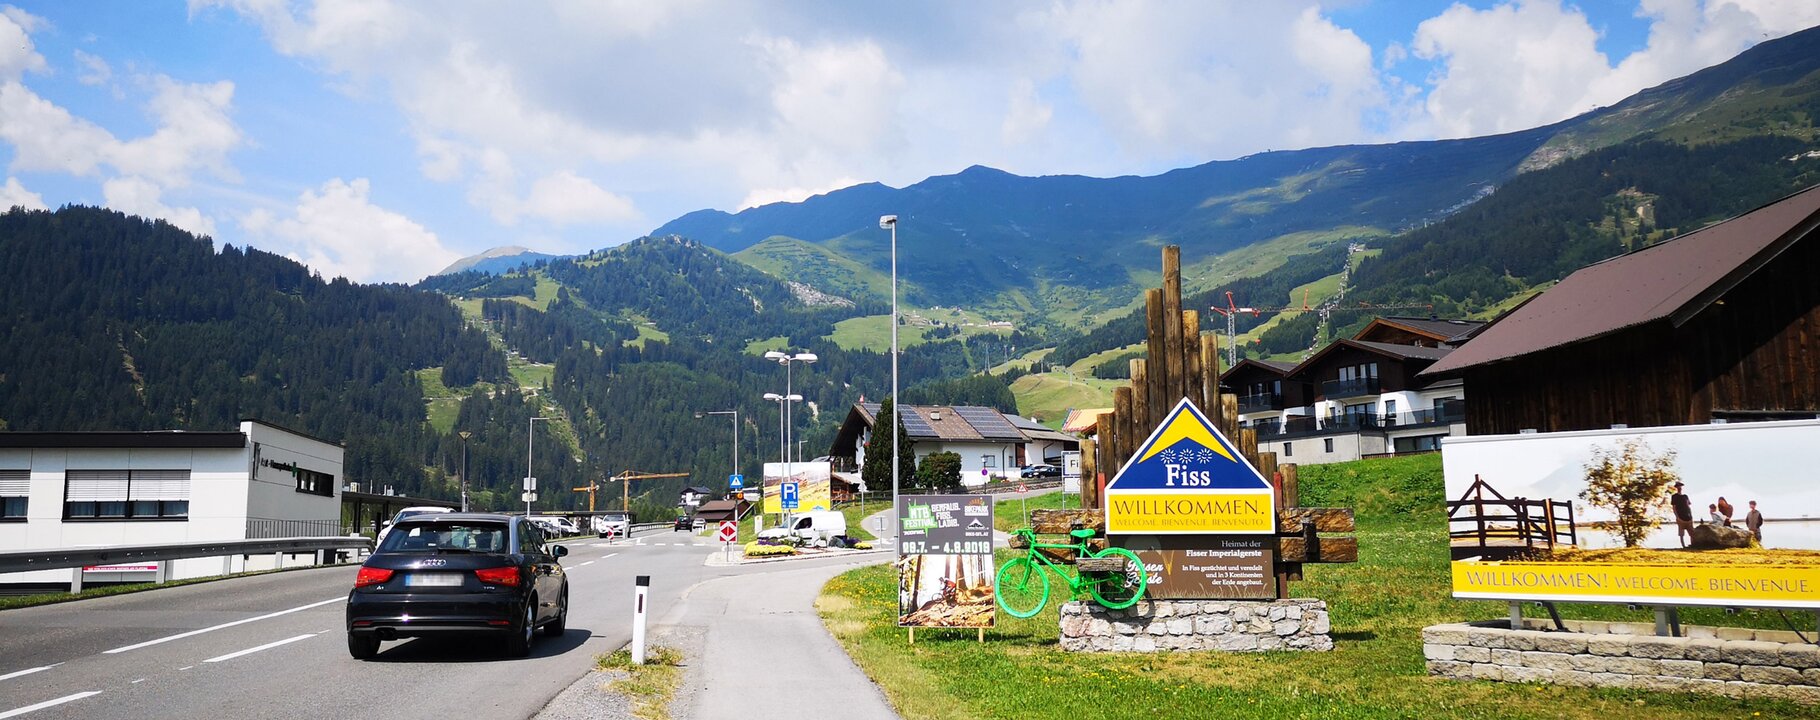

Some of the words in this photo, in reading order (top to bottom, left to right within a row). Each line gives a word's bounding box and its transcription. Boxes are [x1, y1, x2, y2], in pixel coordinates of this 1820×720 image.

[1165, 464, 1211, 486] Fiss
[910, 507, 928, 519] MTB
[1114, 499, 1265, 515] WILLKOMMEN.
[1212, 518, 1265, 526] BENVENUTO.
[1186, 549, 1208, 557] Fisser
[1208, 549, 1263, 558] Imperialgerste
[1200, 565, 1227, 573] gezüchtet
[1124, 572, 1163, 588] Geste
[1236, 579, 1264, 587] angebaut.
[1466, 571, 1608, 589] WILLKOMMEN!
[1614, 576, 1704, 592] WELCOME.
[1709, 577, 1814, 594] BIENVENUE.
